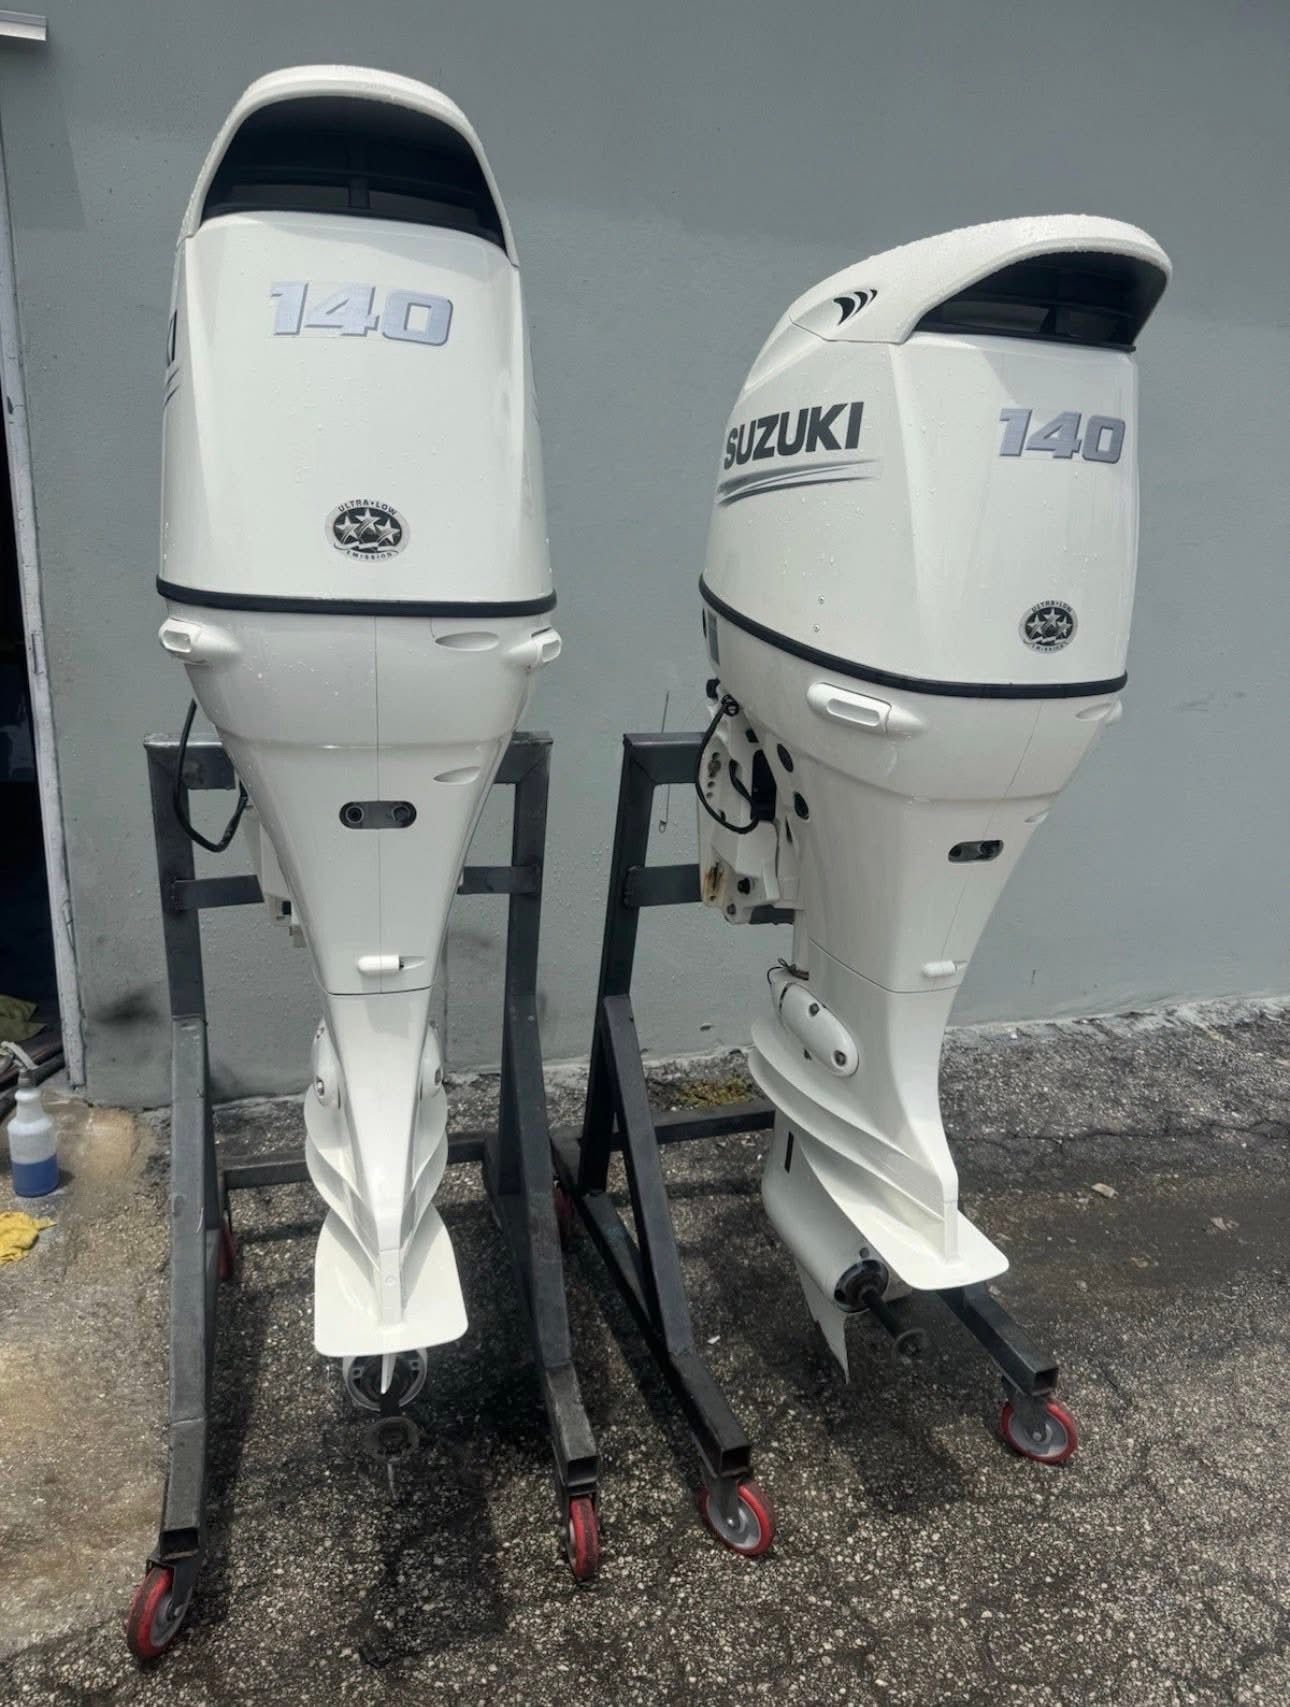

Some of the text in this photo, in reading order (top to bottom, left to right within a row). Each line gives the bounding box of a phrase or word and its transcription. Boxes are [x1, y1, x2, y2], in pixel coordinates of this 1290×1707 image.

[270, 281, 454, 346] 140
[723, 401, 864, 470] SUZUKI
[999, 408, 1126, 464] 140
